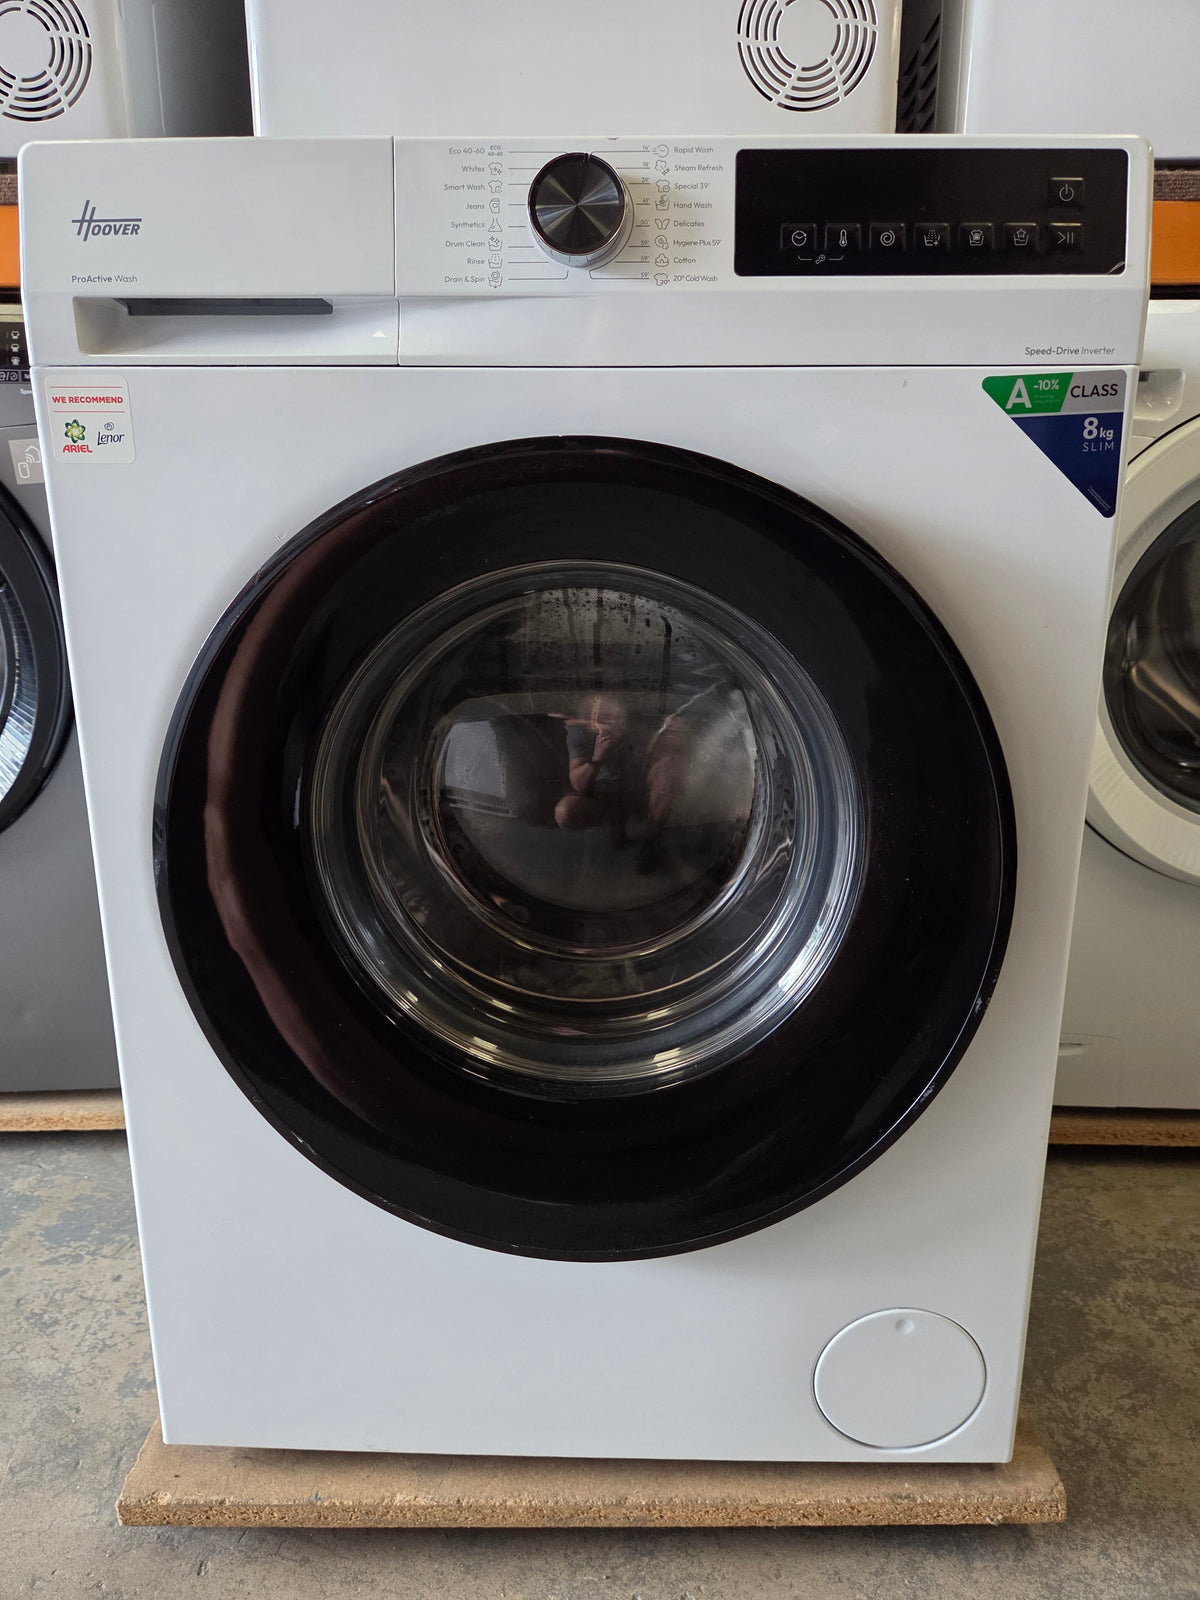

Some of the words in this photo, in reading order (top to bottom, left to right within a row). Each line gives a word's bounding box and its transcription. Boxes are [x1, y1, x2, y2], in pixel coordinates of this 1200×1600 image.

[471, 276, 485, 284] Spin
[1025, 347, 1079, 356] Speed-Drive
[1082, 347, 1115, 355] Inverter
[1033, 379, 1059, 390] -10%
[1005, 379, 1032, 409] A
[1071, 384, 1118, 398] CLASS
[97, 431, 125, 445] Lenor
[63, 445, 93, 453] ARIEL
[1083, 442, 1114, 452] SLIM
